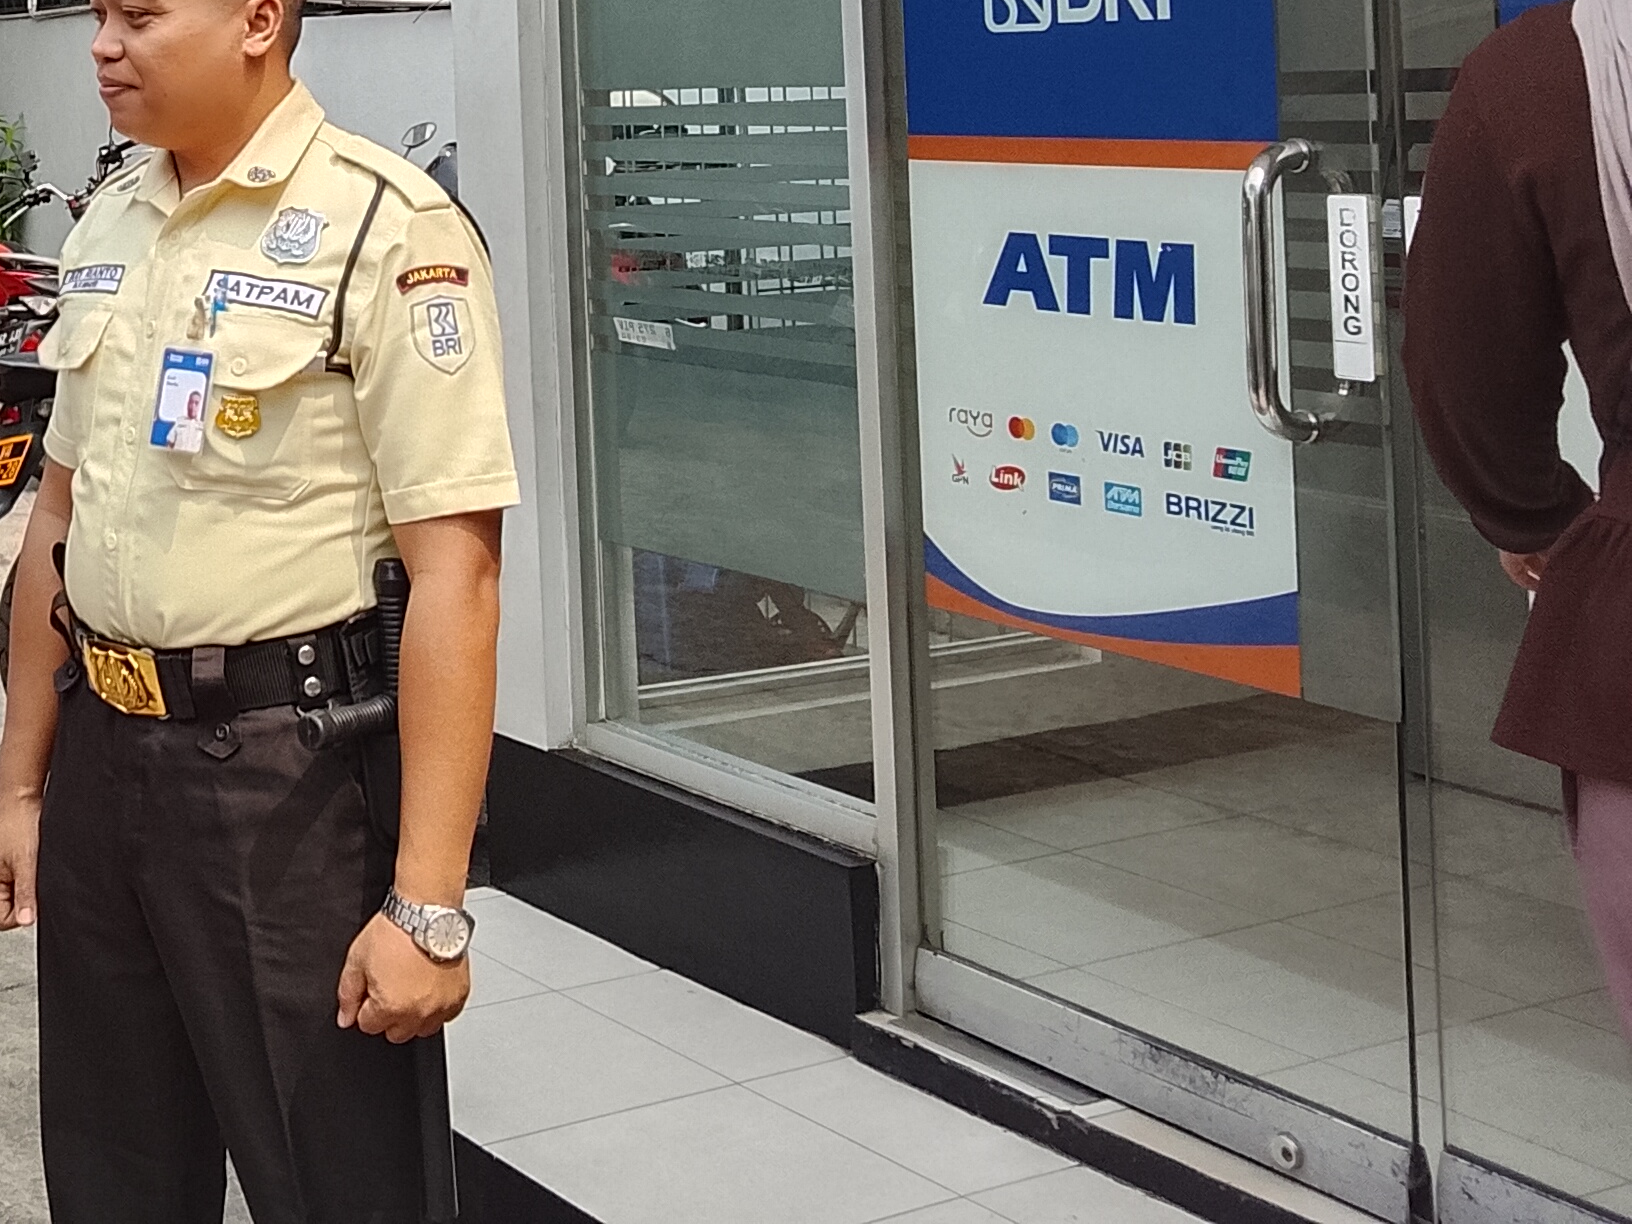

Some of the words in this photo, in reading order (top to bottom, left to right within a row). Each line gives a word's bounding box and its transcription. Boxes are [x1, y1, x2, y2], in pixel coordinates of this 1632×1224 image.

[406, 267, 458, 284] JAKARTA
[982, 231, 1197, 326] ATM
[1338, 207, 1363, 336] DORONG
[432, 336, 463, 358] BRI
[948, 407, 993, 429] raya
[1096, 430, 1145, 458] VISA
[990, 466, 1024, 490] Link
[1051, 482, 1078, 494] PRIMA
[1106, 485, 1140, 505] ATM
[1165, 492, 1254, 530] BRIZZI
